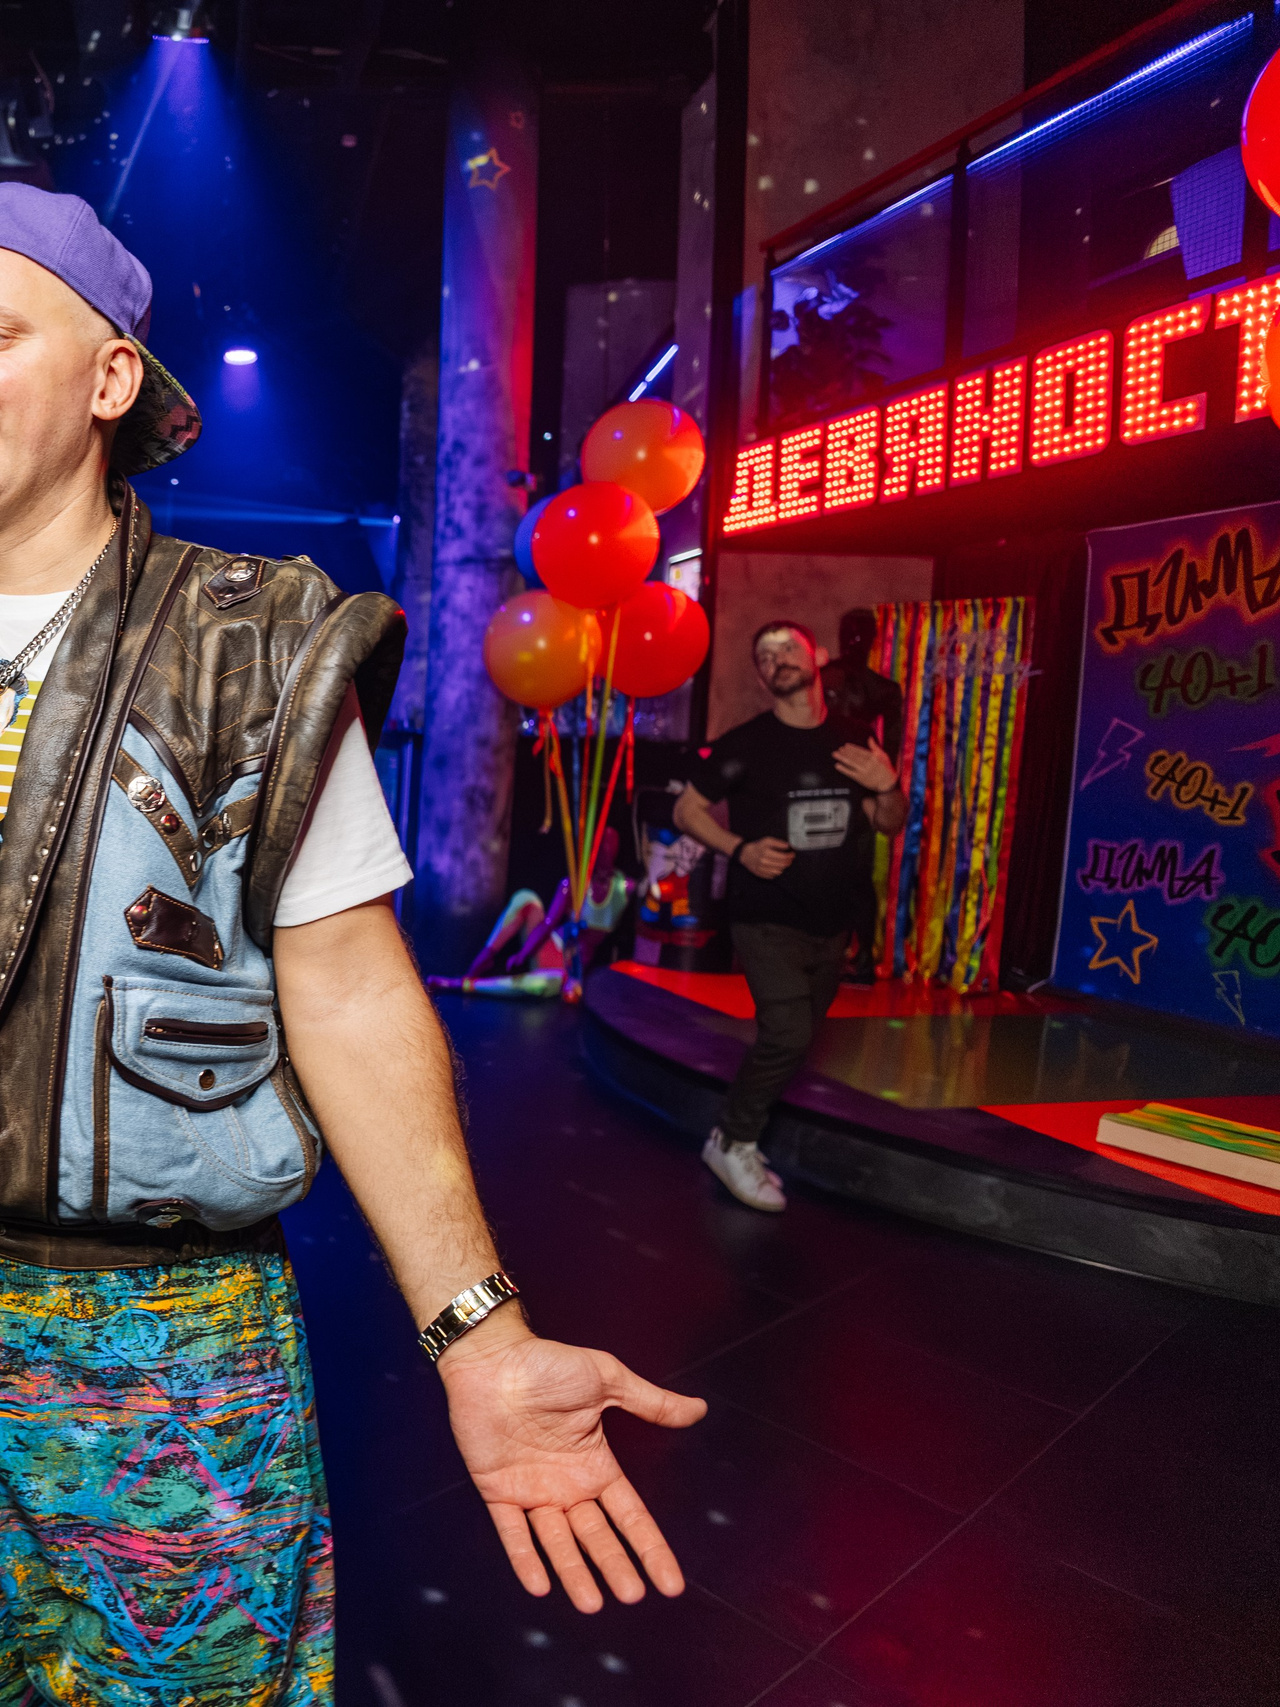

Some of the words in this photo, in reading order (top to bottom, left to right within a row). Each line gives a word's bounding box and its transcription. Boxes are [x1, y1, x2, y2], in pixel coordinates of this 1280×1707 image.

[1139, 645, 1275, 714] 40+1
[1149, 755, 1250, 821] 40+1
[1084, 843, 1219, 900] ДИМА
